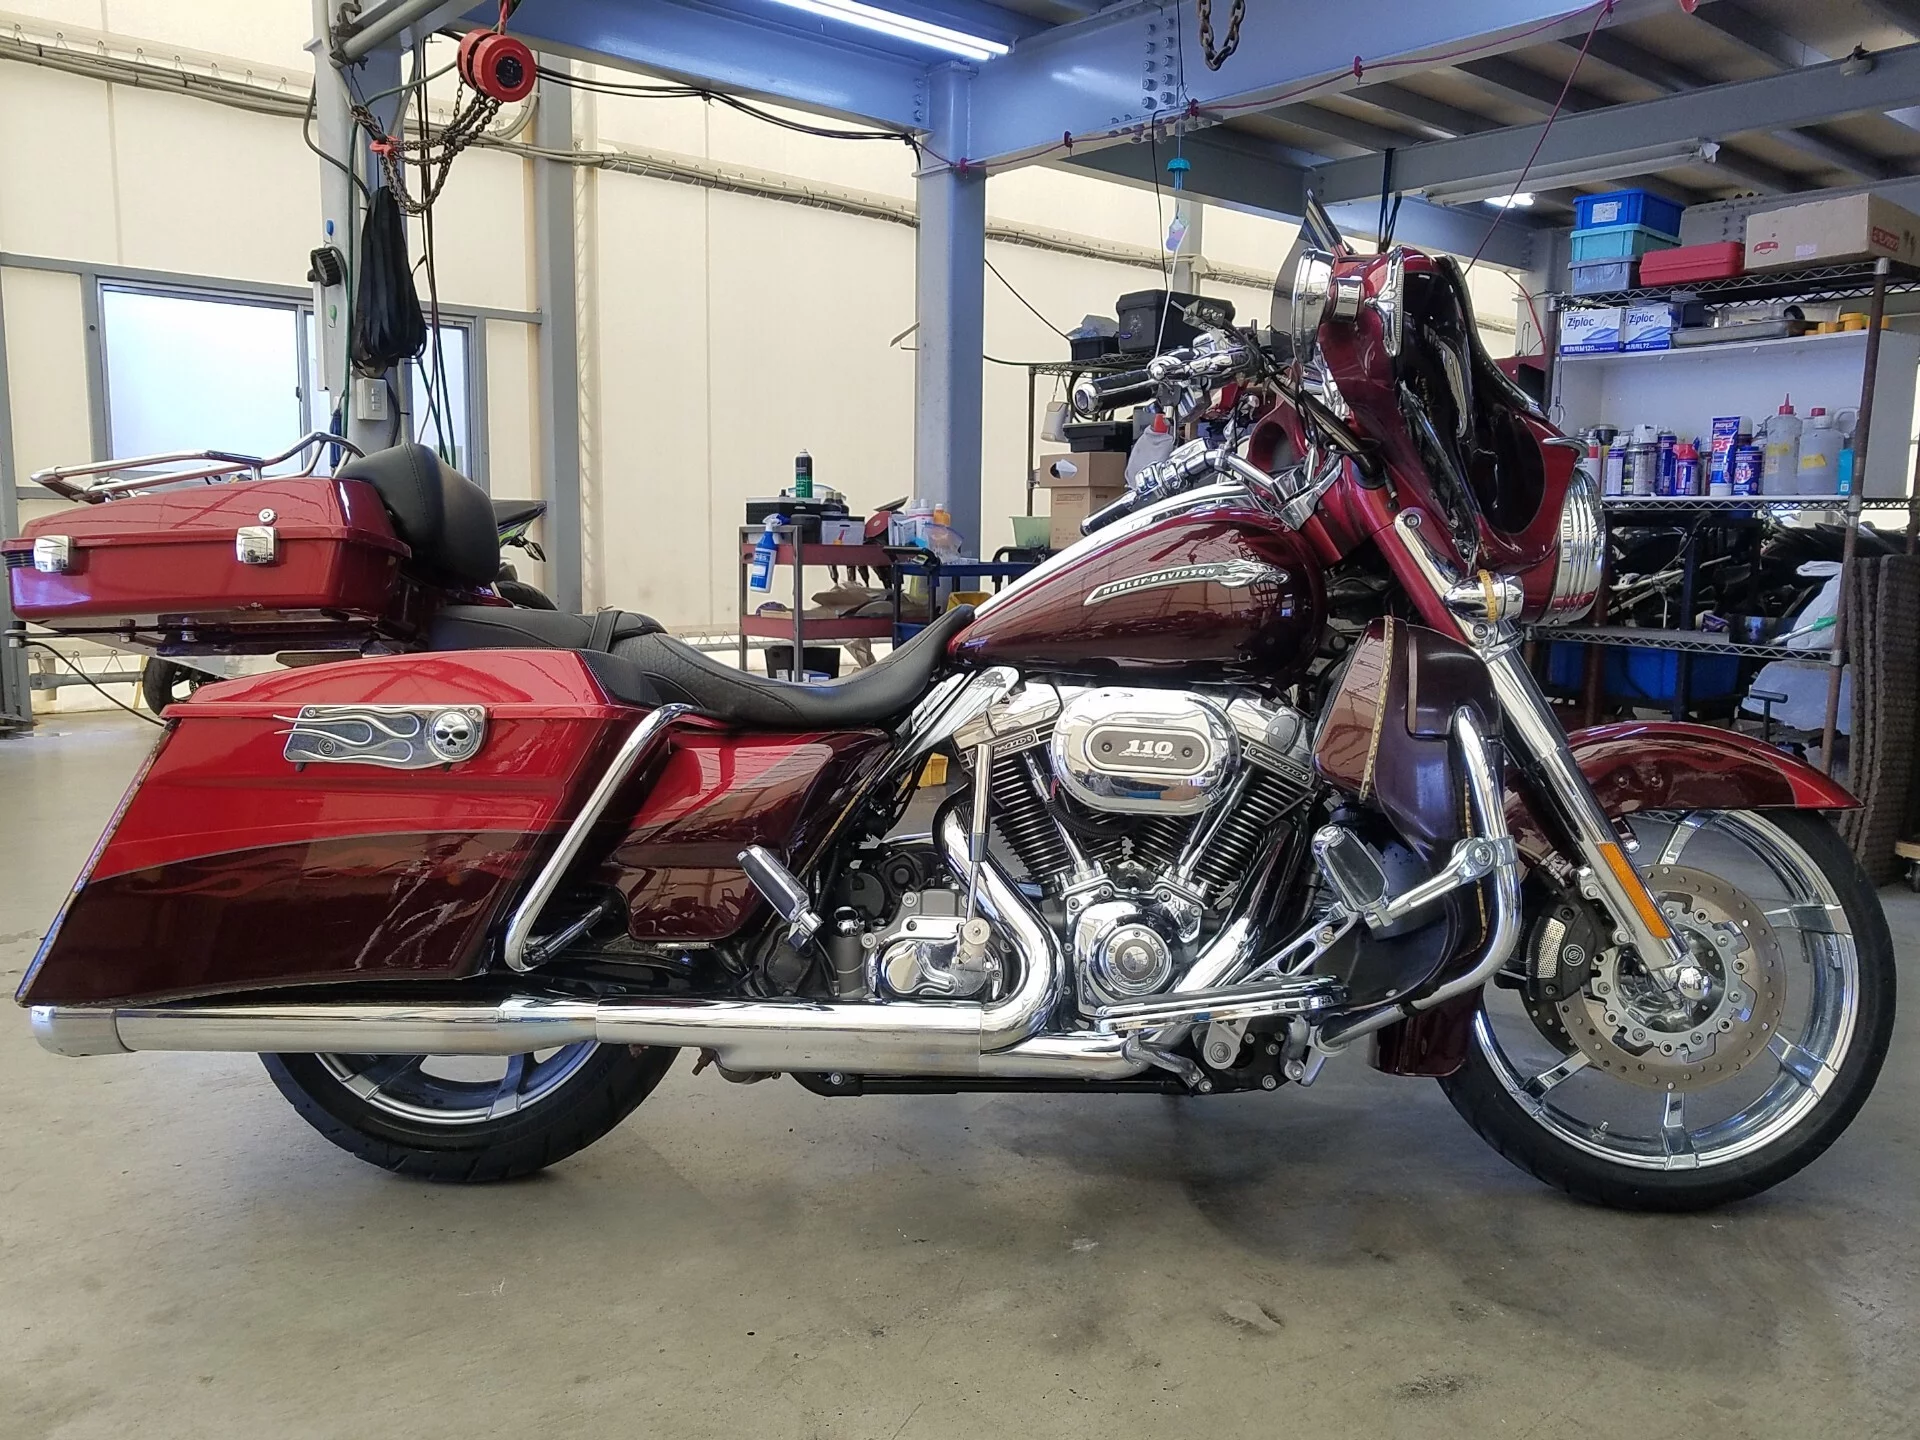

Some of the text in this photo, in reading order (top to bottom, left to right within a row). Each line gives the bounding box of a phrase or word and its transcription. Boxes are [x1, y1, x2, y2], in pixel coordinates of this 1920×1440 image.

[1567, 317, 1595, 330] Ziploc
[1629, 313, 1655, 325] Ziploc
[1103, 568, 1216, 594] HARLEY-DAVIDSON
[1125, 739, 1174, 755] 110
